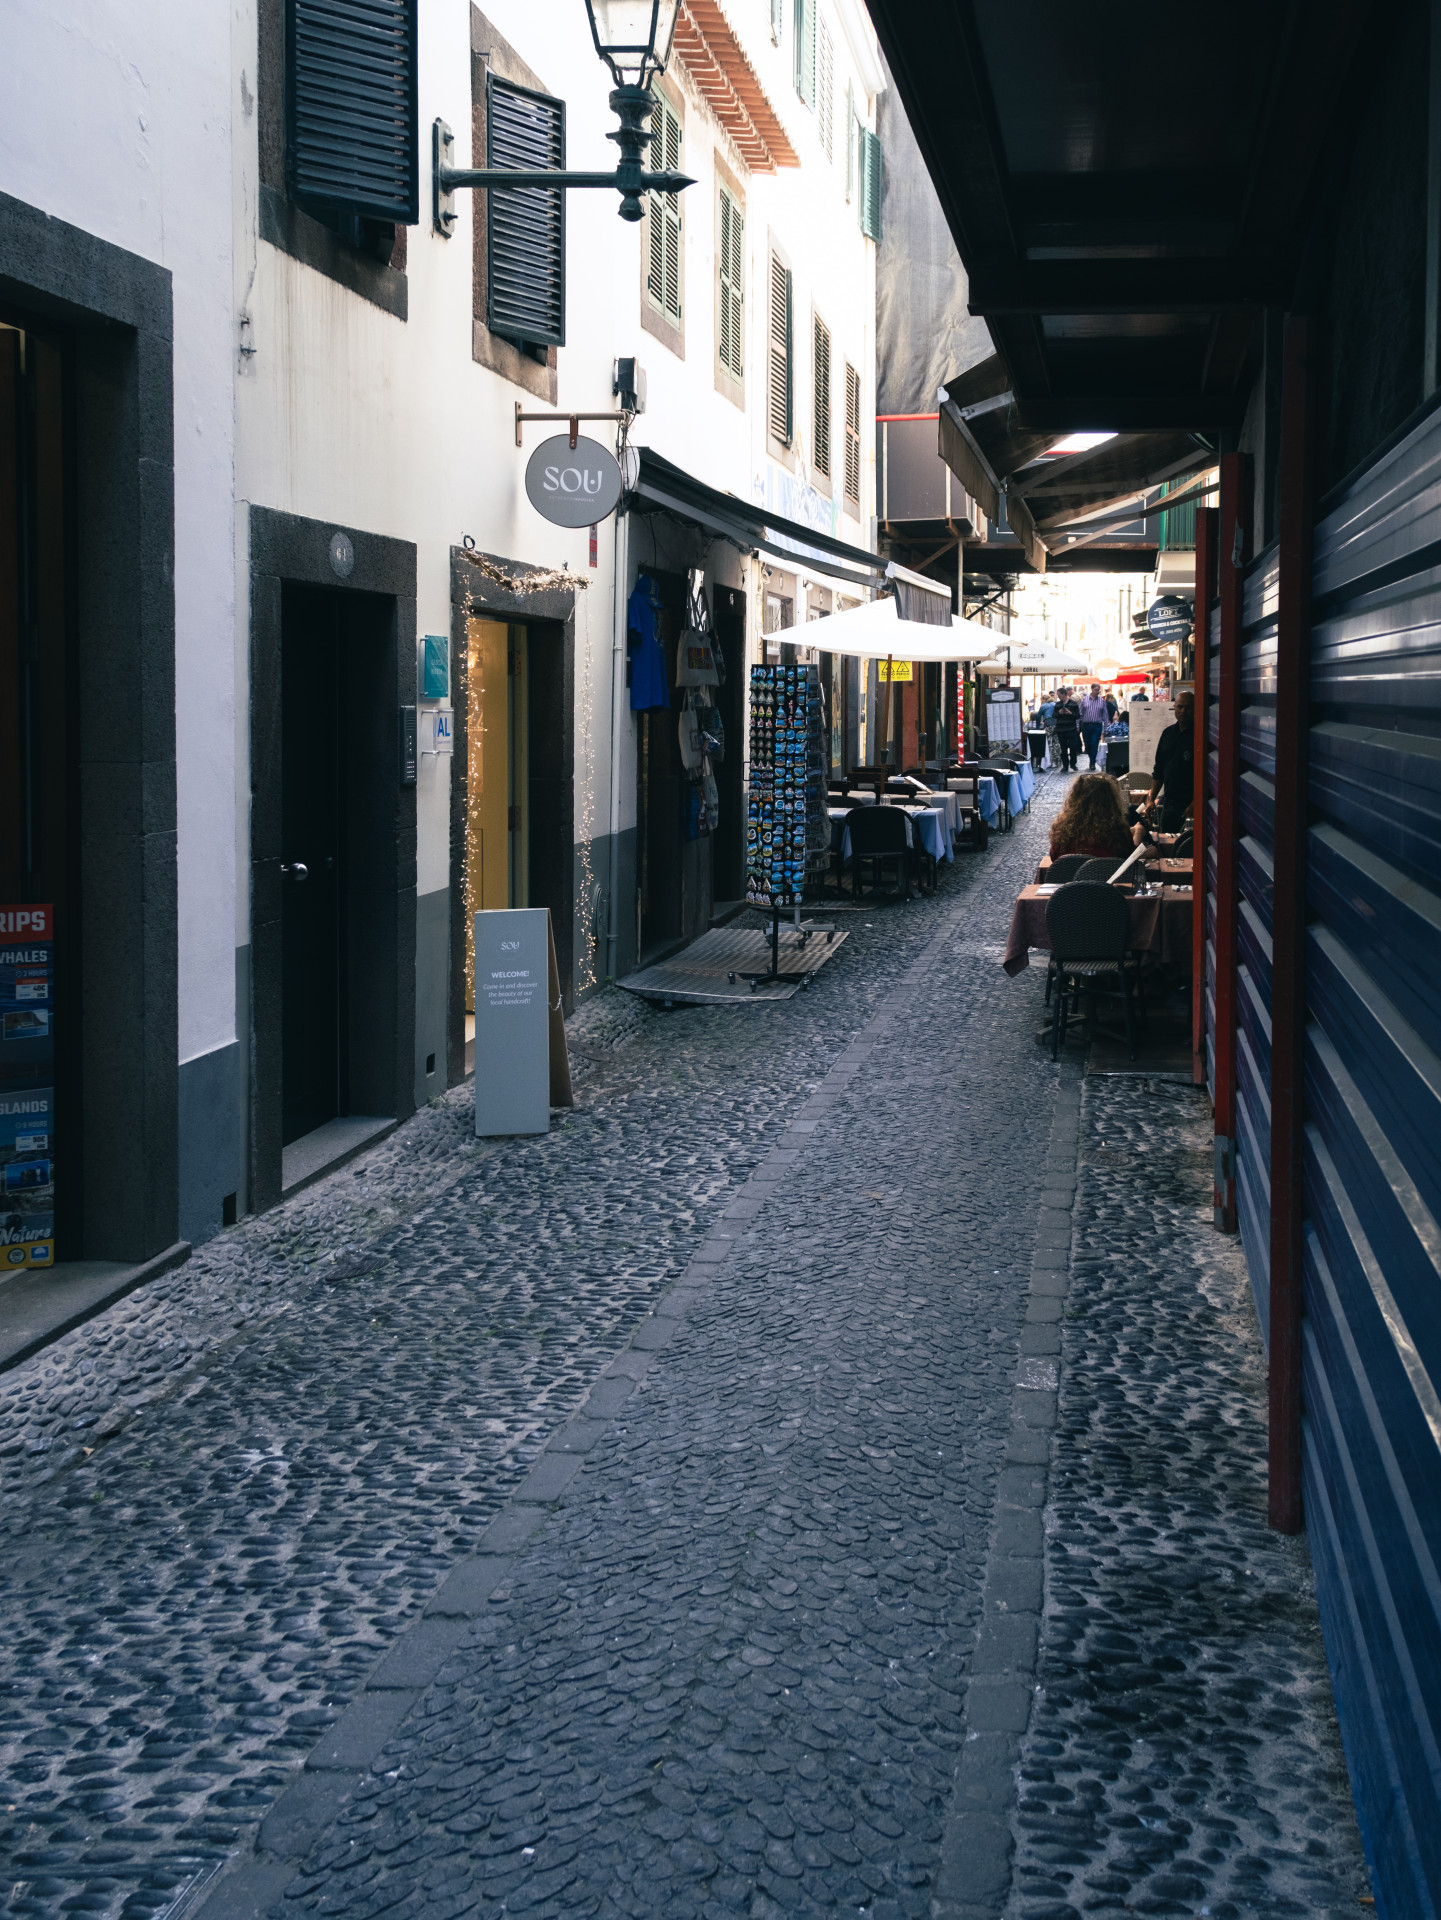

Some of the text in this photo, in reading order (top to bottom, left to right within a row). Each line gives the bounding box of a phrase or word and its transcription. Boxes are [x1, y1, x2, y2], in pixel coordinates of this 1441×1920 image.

[542, 466, 603, 494] SOU
[437, 717, 451, 738] AL
[500, 941, 520, 951] SOU
[491, 970, 530, 979] WELCOME!
[498, 991, 516, 999] beauty
